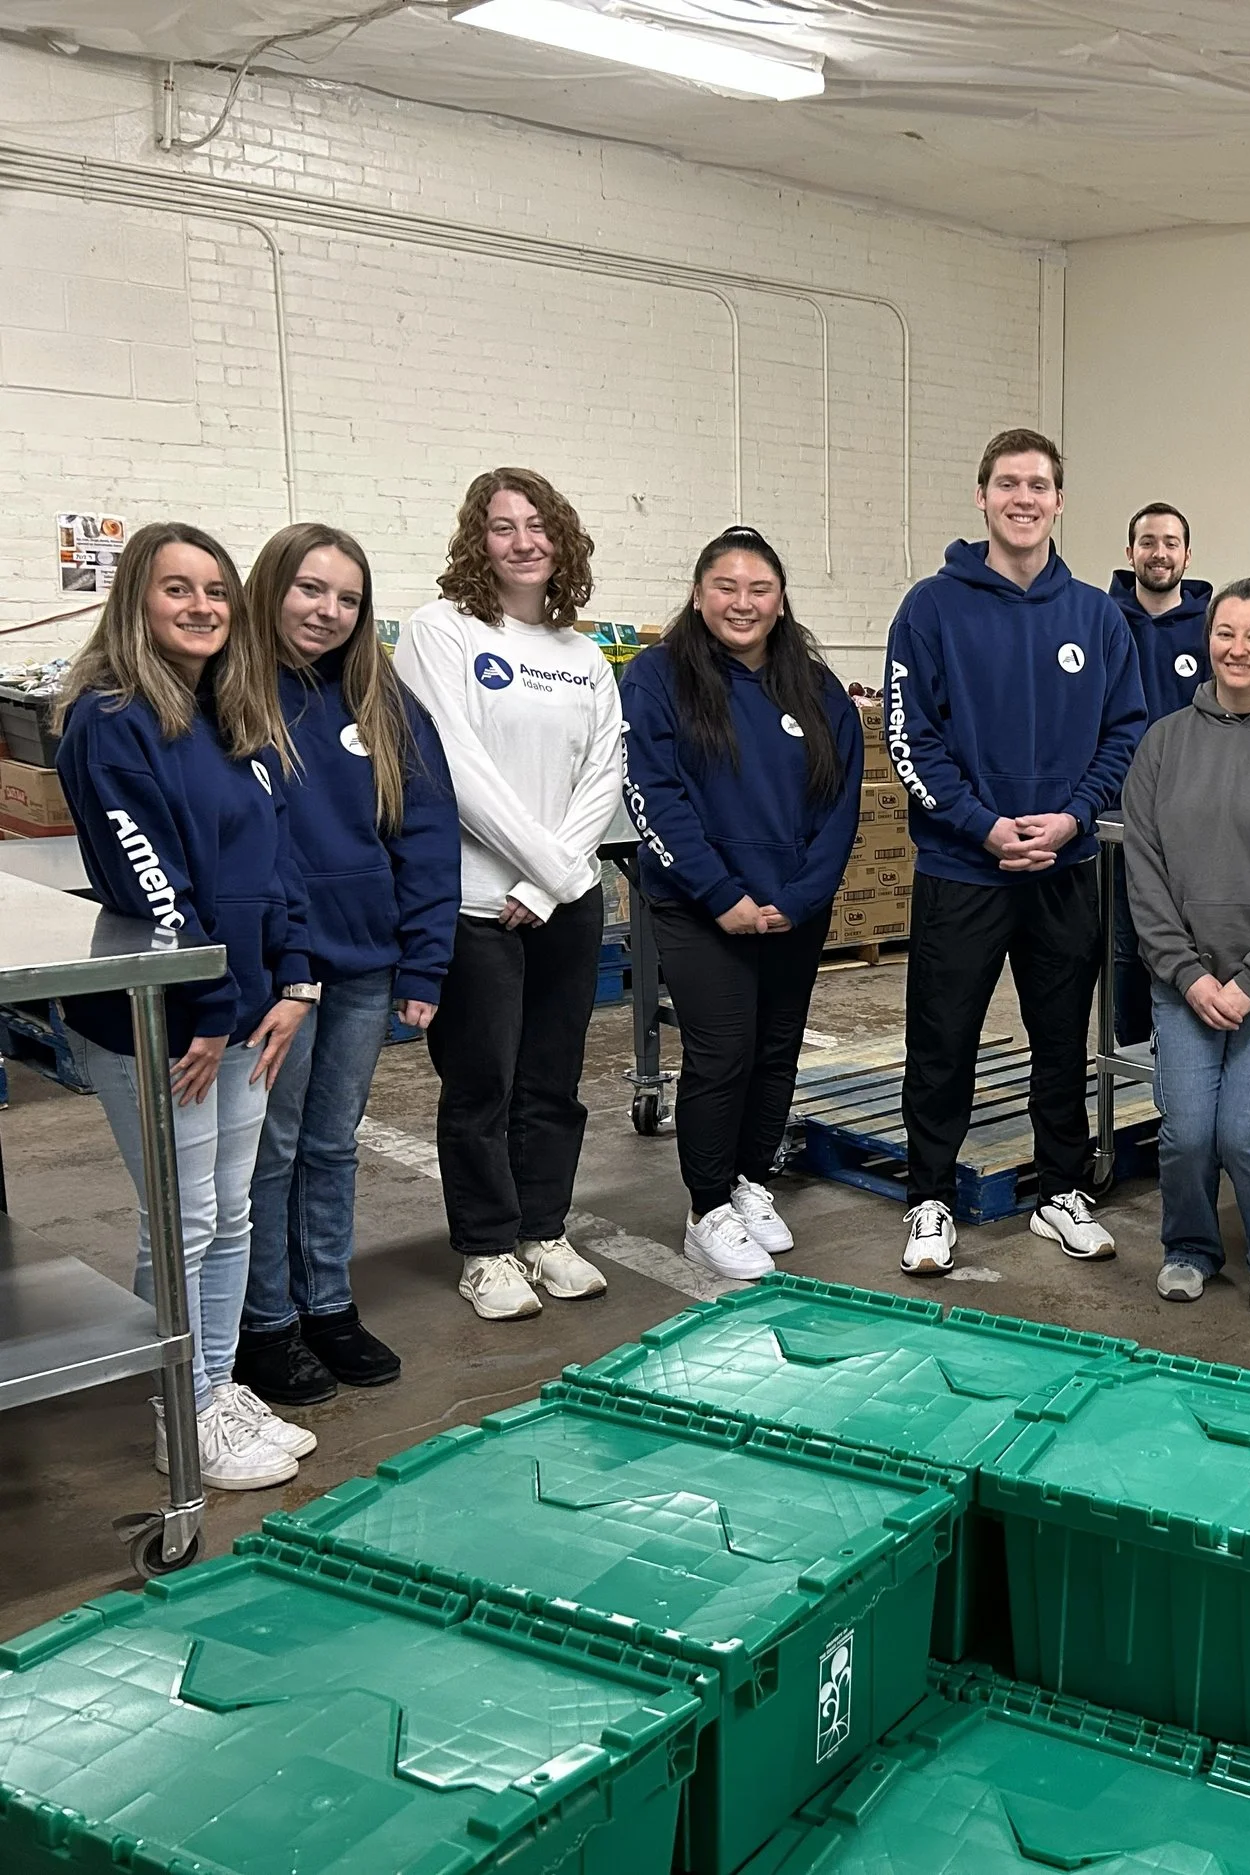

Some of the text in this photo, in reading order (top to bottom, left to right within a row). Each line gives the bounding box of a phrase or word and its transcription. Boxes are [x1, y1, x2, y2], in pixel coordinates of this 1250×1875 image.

[522, 678, 553, 693] Idaho
[888, 660, 937, 810] AmeriCorps
[882, 873, 897, 882] Dole
[848, 912, 864, 922] Dole
